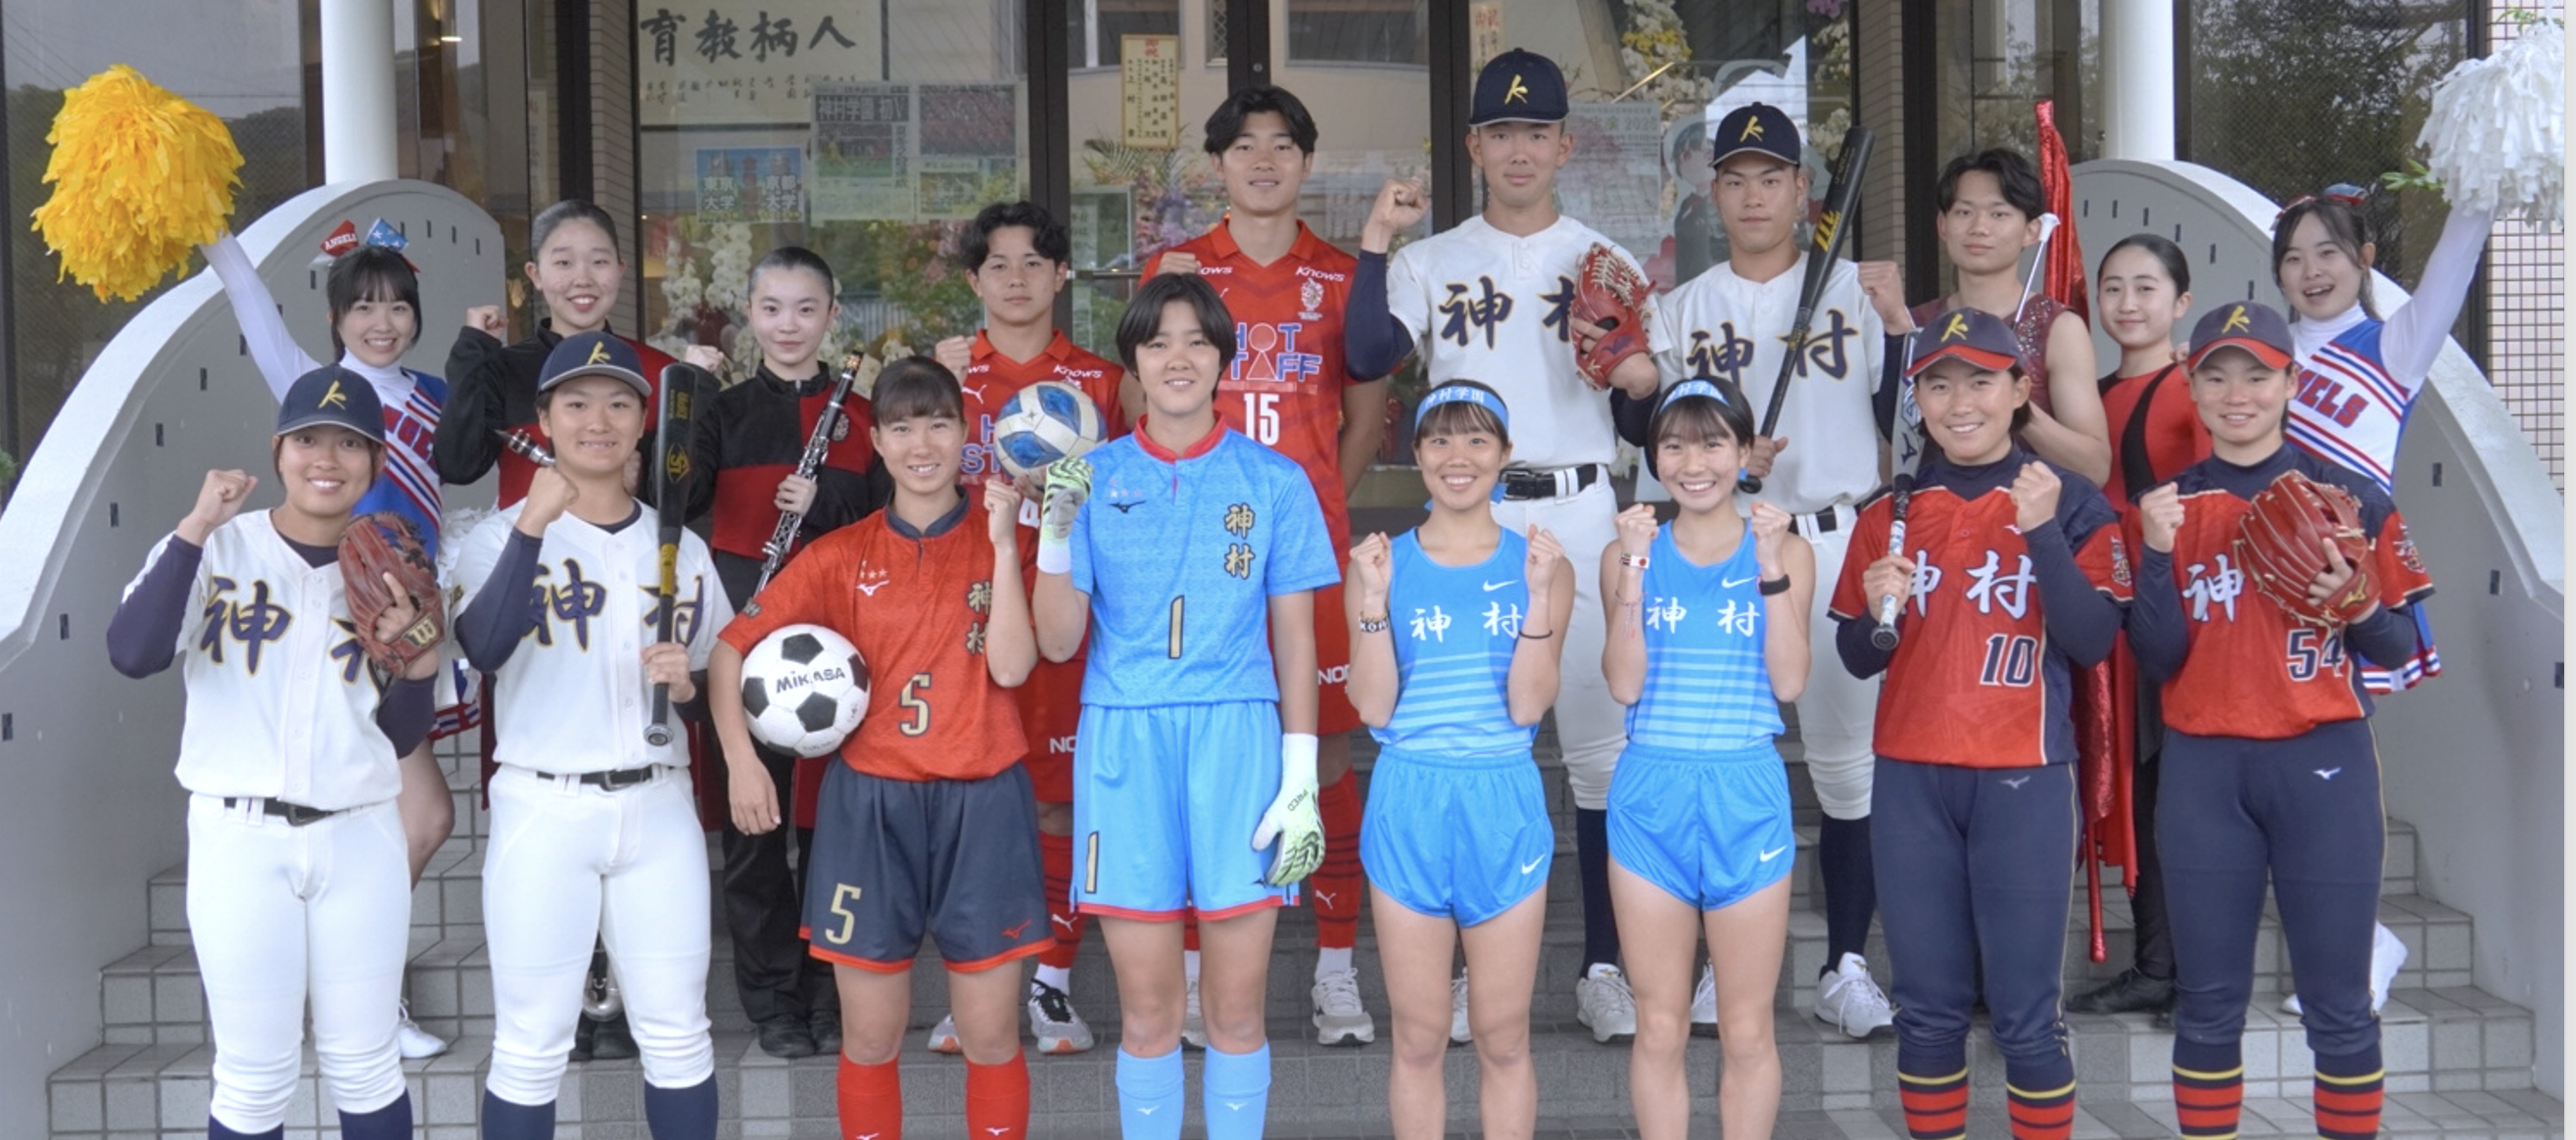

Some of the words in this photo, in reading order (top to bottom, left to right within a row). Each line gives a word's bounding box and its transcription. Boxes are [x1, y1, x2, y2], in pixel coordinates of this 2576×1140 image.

[1295, 265, 1346, 282] Knows
[1053, 363, 1104, 379] Knows
[1230, 351, 1323, 382] TAFF
[1243, 392, 1281, 447] 15
[1223, 501, 1256, 580] 神村
[1168, 594, 1185, 660] 1
[1408, 599, 1523, 643] 神村
[1645, 594, 1761, 638] 神村
[1980, 633, 2038, 688] 10
[2285, 627, 2345, 683] 54
[899, 672, 931, 736] 5
[1083, 831, 1100, 894] 1
[824, 881, 862, 945] 5
